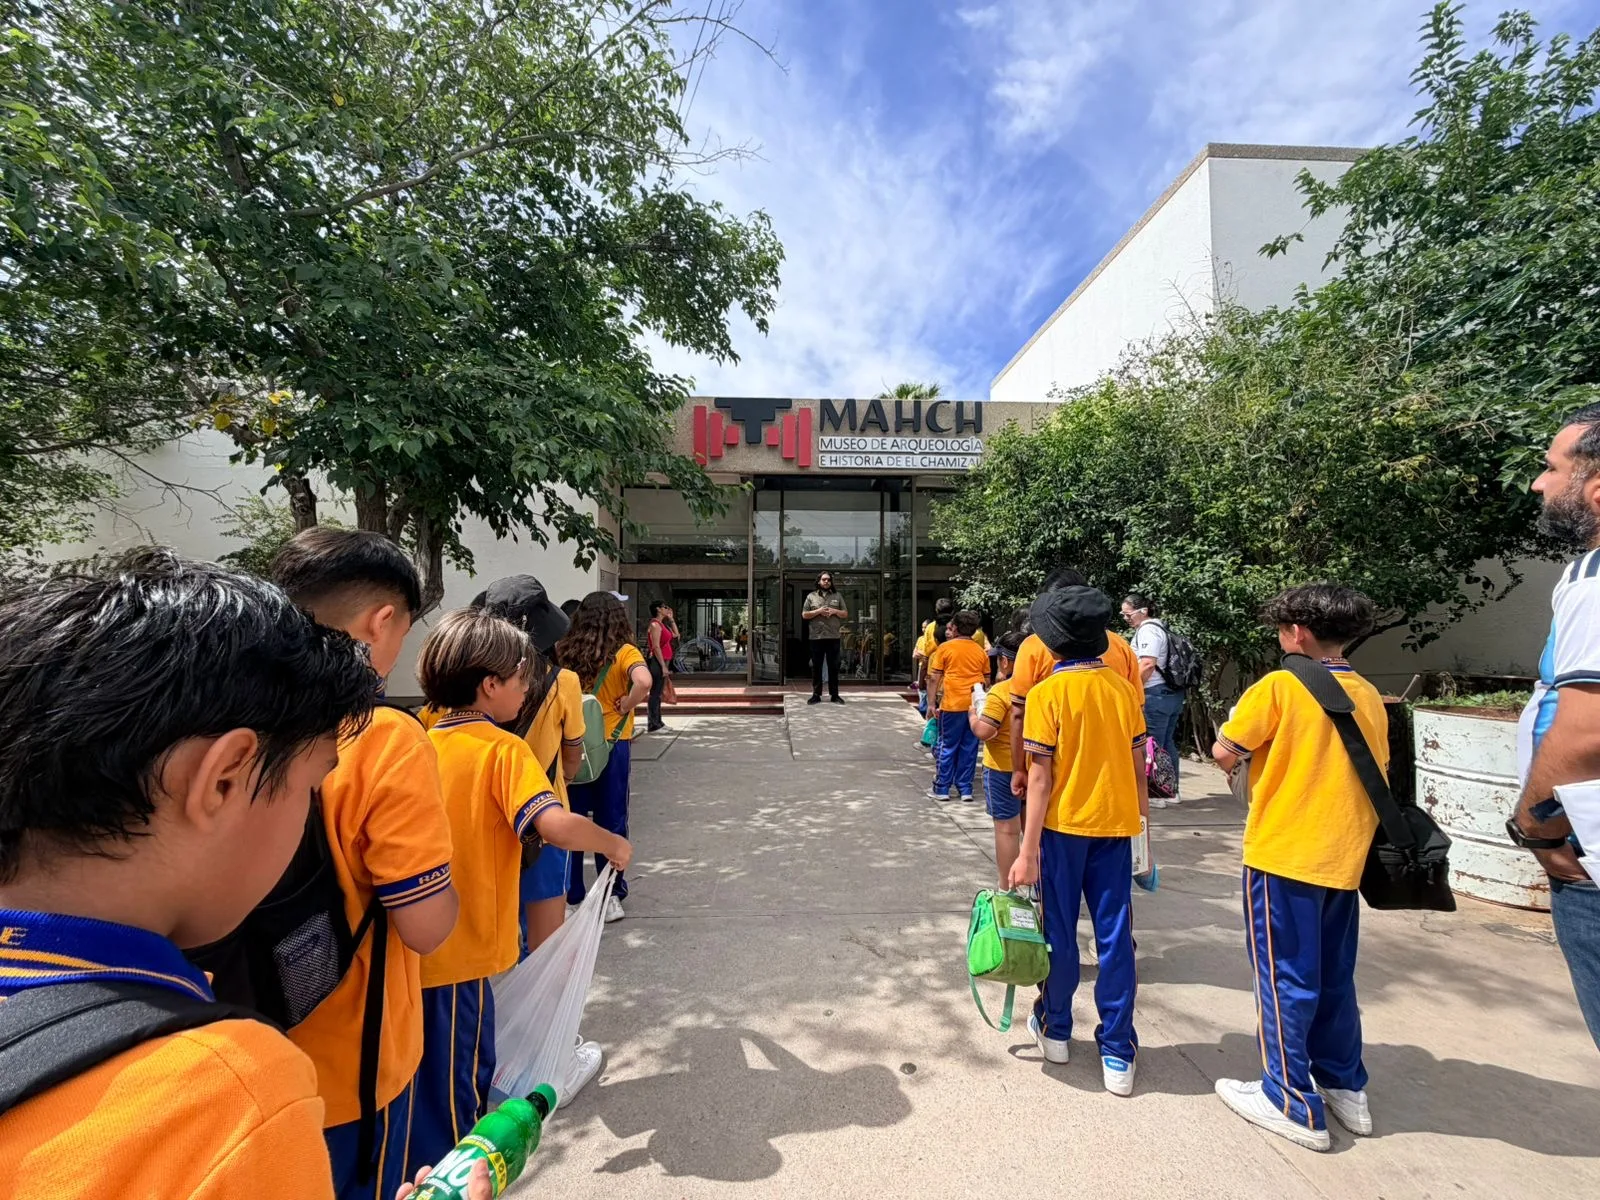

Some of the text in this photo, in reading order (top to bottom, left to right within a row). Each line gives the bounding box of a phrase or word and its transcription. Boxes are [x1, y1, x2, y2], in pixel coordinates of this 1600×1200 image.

[819, 398, 983, 434] MAHCH
[820, 436, 983, 453] MUSEO DE ARQUEOLOGÍA
[820, 455, 826, 466] E
[829, 455, 884, 467] HISTORIA
[886, 456, 902, 467] DE
[905, 456, 918, 467] EL
